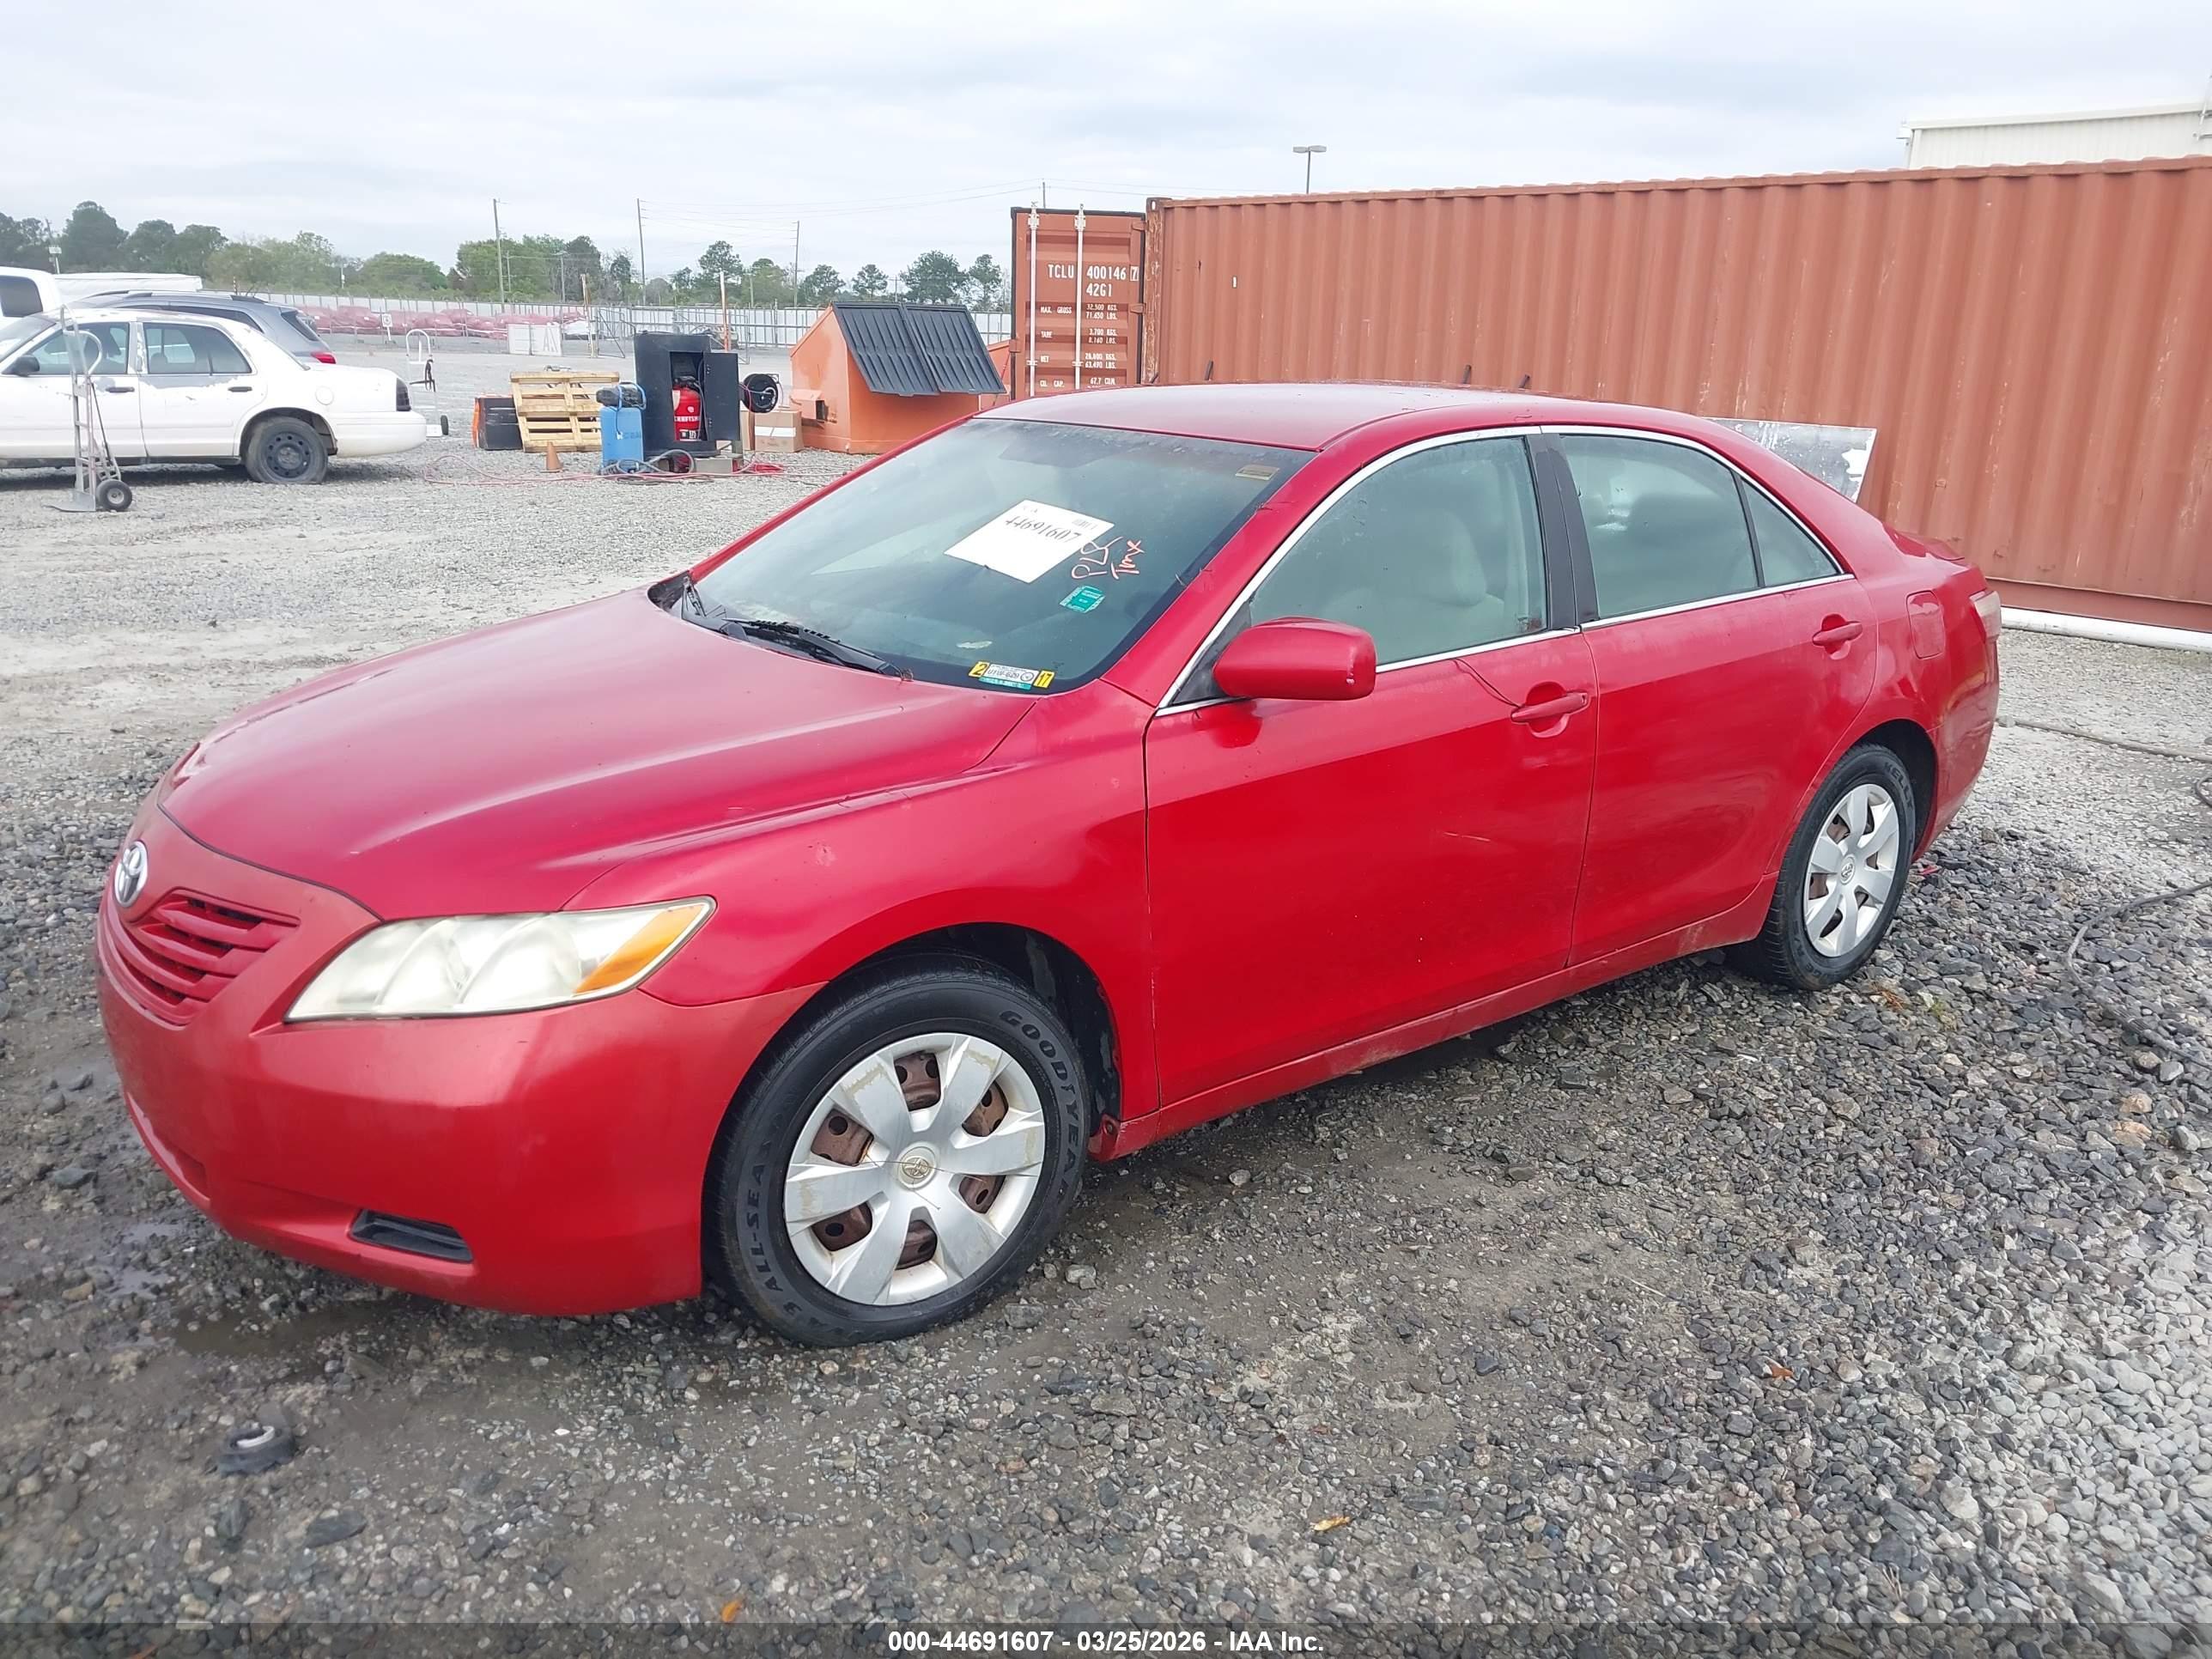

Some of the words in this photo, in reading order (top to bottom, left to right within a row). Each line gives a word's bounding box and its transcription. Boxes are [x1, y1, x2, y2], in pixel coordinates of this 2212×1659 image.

[1048, 264, 1074, 279] TCLU
[1086, 265, 1127, 281] 400146
[1130, 266, 1139, 282] 7
[1085, 283, 1113, 297] 42G1
[971, 662, 988, 676] 2
[1036, 672, 1053, 686] 17
[999, 1009, 1079, 1198] GOODYEAR
